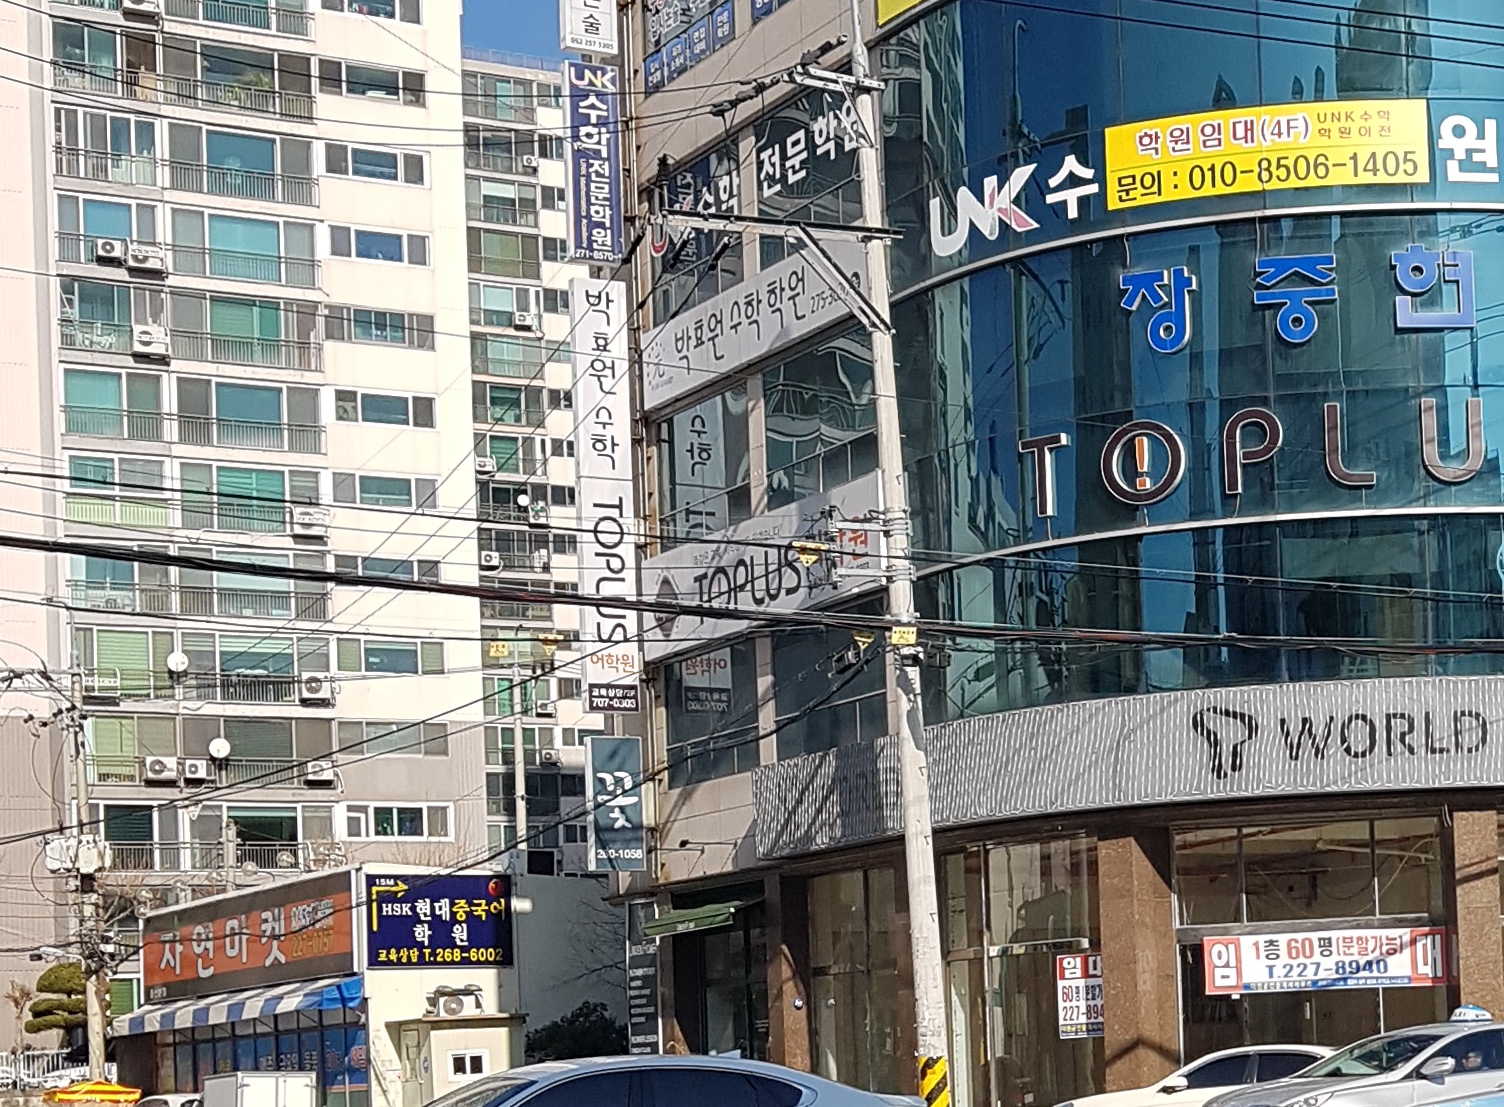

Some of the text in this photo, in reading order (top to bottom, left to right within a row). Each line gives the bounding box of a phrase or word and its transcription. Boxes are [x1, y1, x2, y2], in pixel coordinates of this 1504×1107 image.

[569, 66, 617, 92] UNK
[578, 93, 611, 159] 수학
[1137, 115, 1310, 157] 학원임대(4F)
[1317, 125, 1392, 140] 학원이전
[1438, 114, 1500, 183] 원
[1188, 150, 1419, 191] 010-8506-1405
[588, 158, 613, 251] 전문학원
[929, 153, 1099, 257] UNK 수
[674, 316, 725, 376] 박효원
[730, 289, 765, 342] 수학
[765, 265, 807, 329] 학원
[584, 289, 616, 396] 박효원
[591, 405, 619, 471] 수학
[592, 495, 628, 643] TOPLUS
[694, 545, 803, 611] TOPLUS
[590, 652, 635, 674] 어학원
[591, 697, 637, 708] 707-0303
[1279, 710, 1488, 761] WORLD
[596, 770, 640, 829] 꽃
[375, 878, 395, 886] 15M
[382, 903, 413, 916] HSK
[377, 947, 504, 963] 교육상담 T.268-6002
[1210, 941, 1238, 987] 임
[1252, 934, 1404, 961] 1층 60평 (분할가능)
[1265, 958, 1389, 980] T.227-8940
[1416, 933, 1443, 978] 대
[1062, 985, 1081, 1003] 60평
[1062, 1003, 1104, 1022] 227-894
